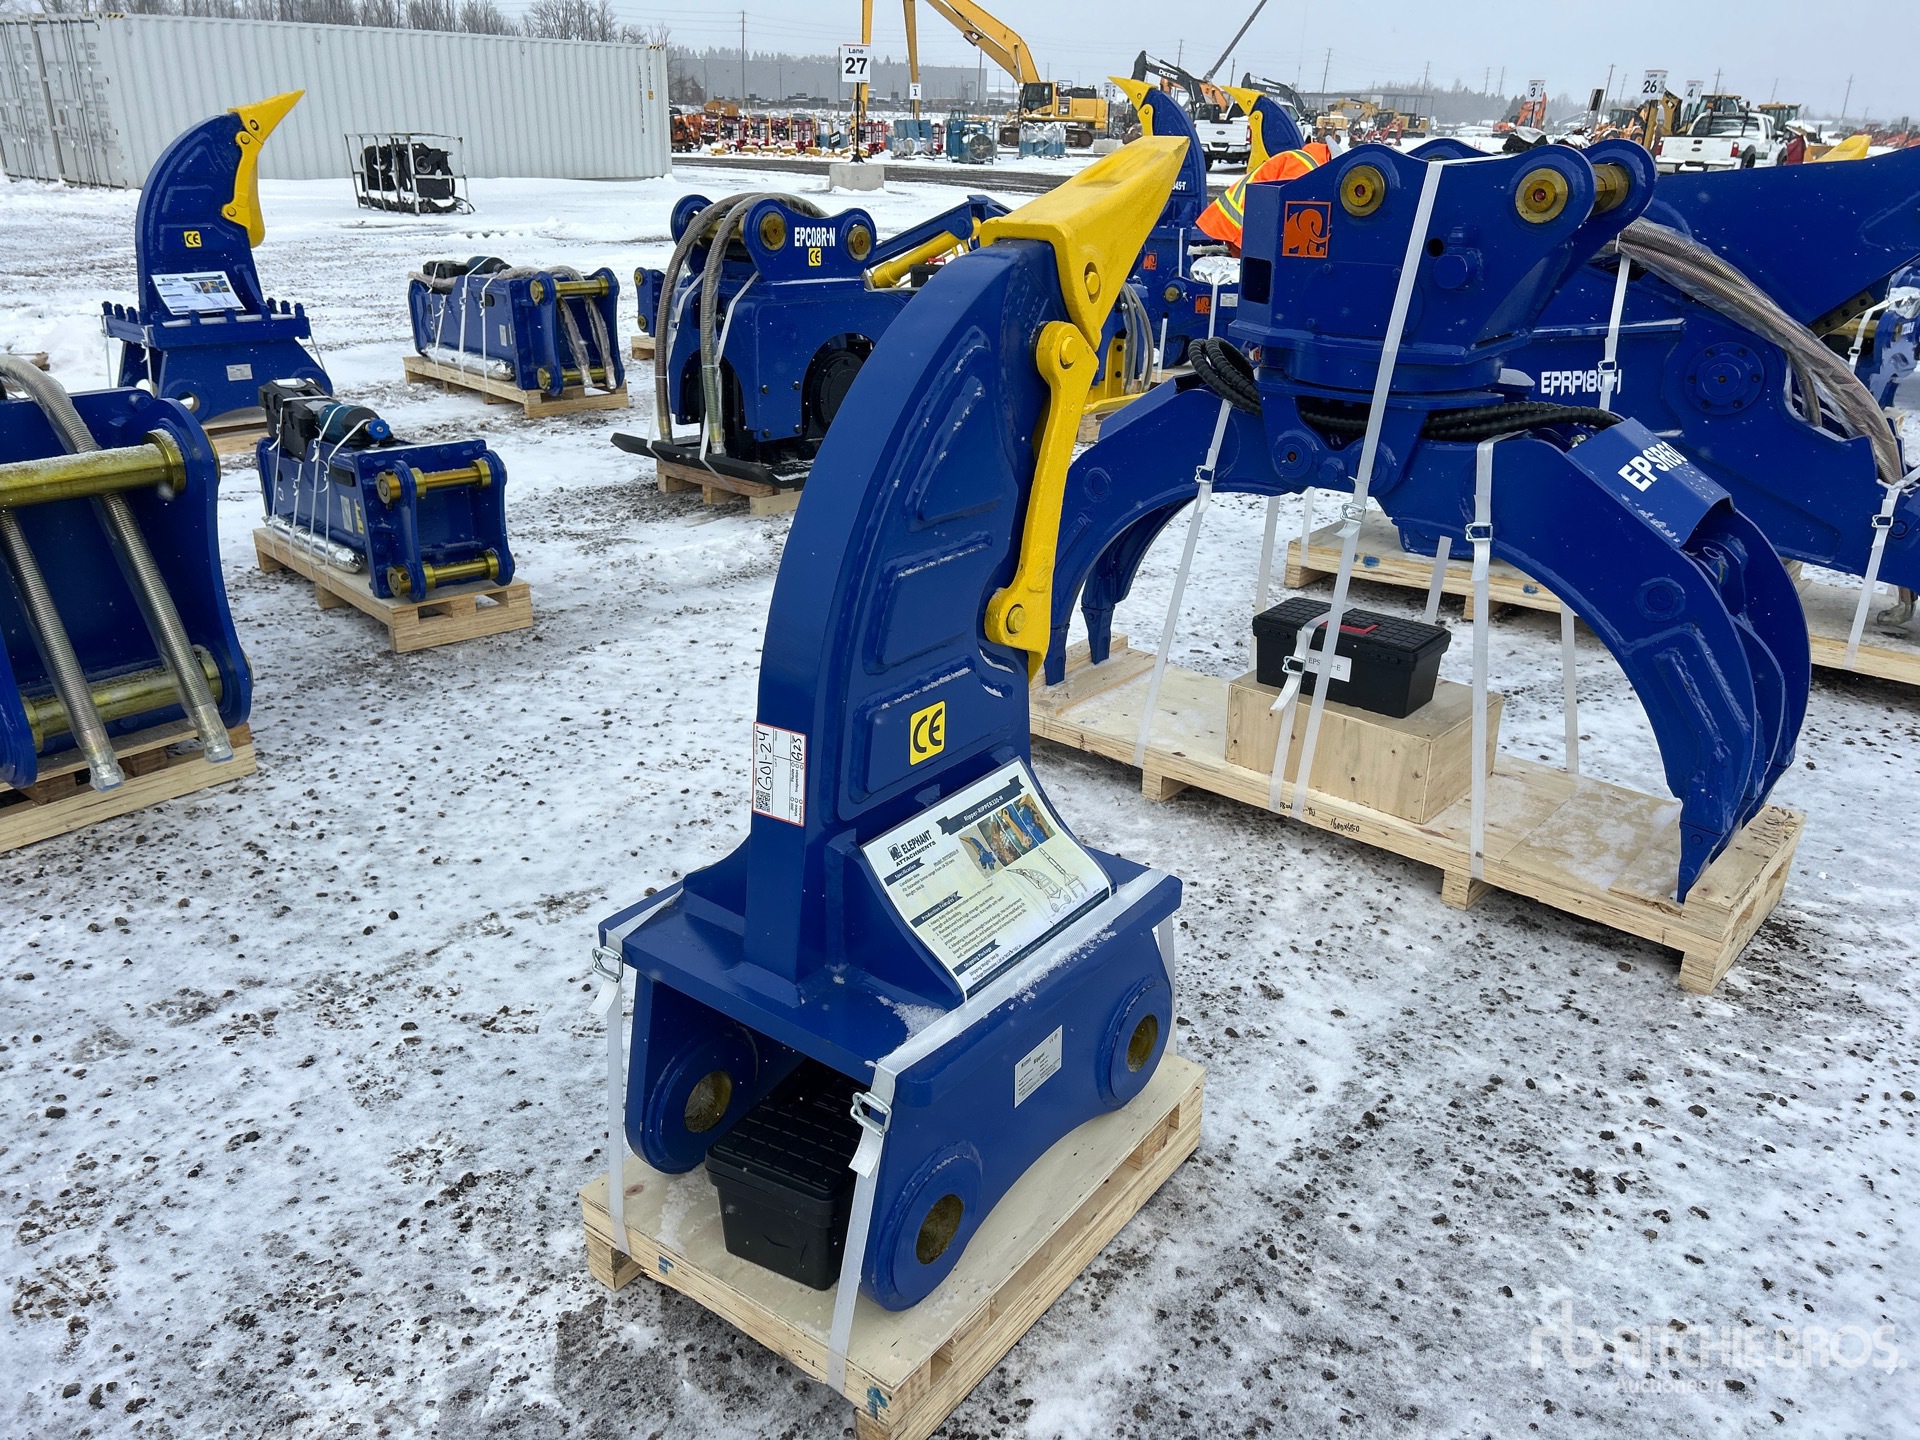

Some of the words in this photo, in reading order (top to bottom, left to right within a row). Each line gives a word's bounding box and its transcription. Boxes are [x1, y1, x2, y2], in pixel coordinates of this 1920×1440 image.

[845, 57, 868, 74] 27
[1158, 68, 1178, 80] DEERE
[1530, 87, 1536, 97] 3
[1643, 80, 1657, 93] 26
[1687, 88, 1694, 98] 4
[186, 233, 200, 245] CE
[794, 227, 836, 247] EPC08R-N
[810, 250, 820, 264] CE
[1617, 441, 1688, 492] EPSR60
[913, 708, 942, 753] CE
[902, 830, 932, 854] ELEPHANT
[896, 840, 936, 867] ATTACHMENTS
